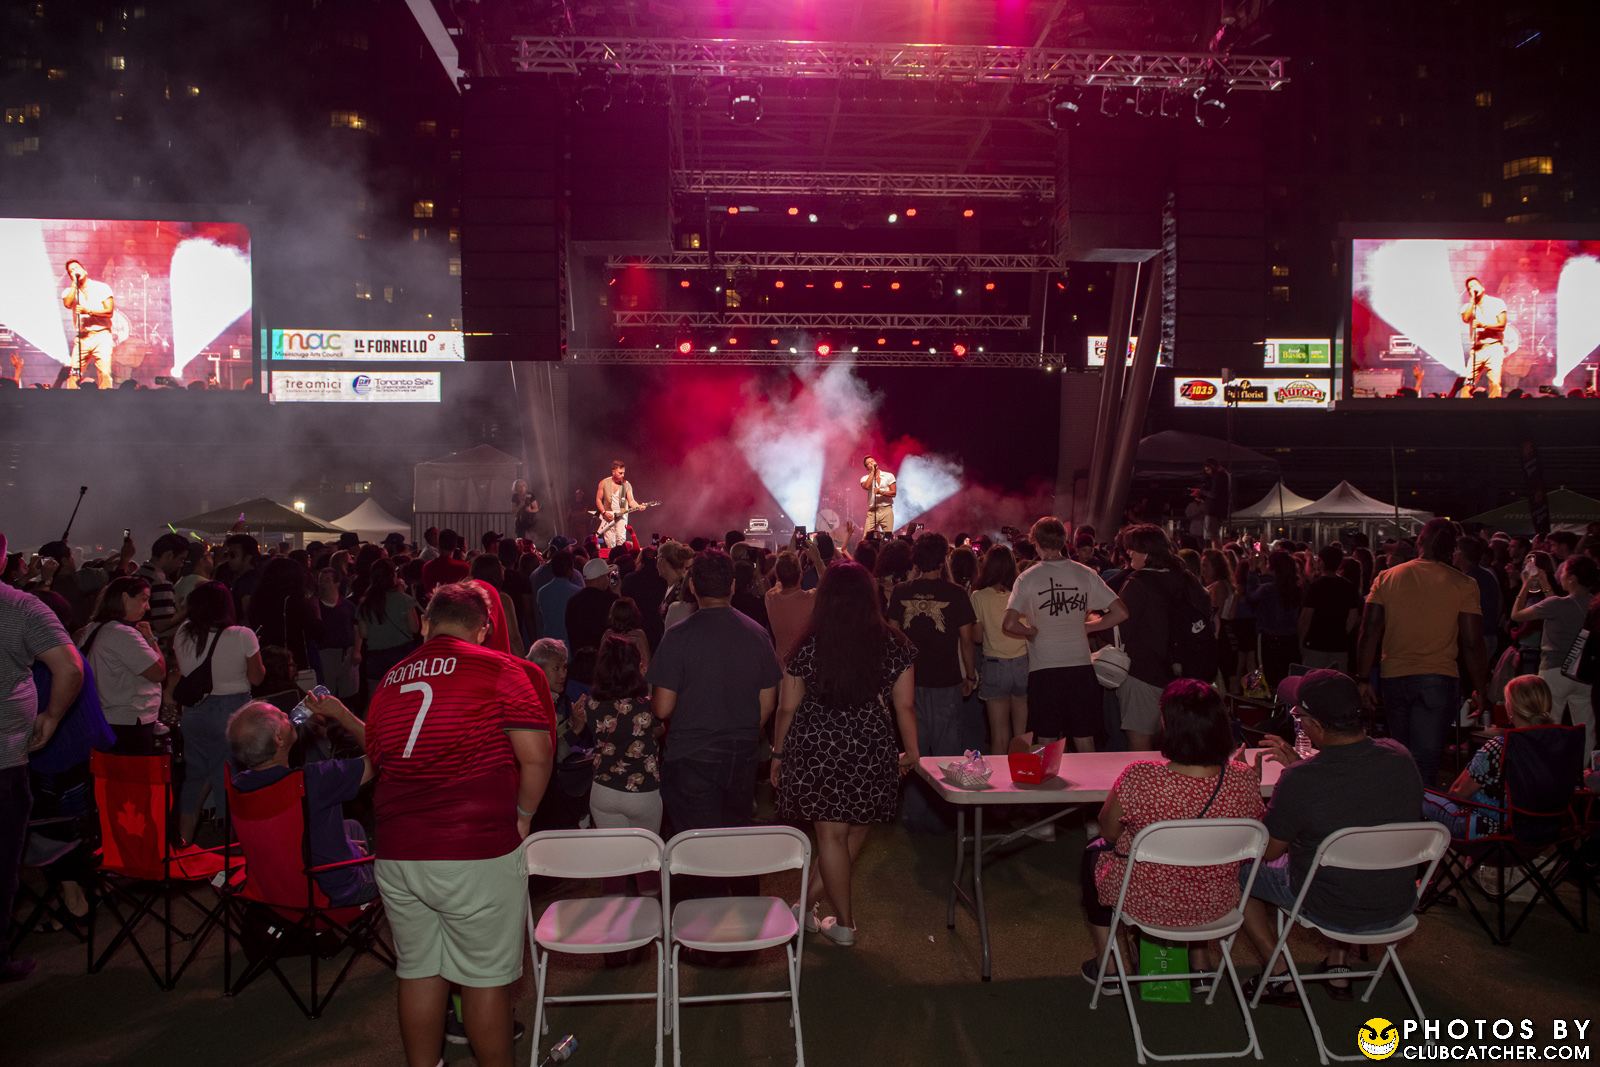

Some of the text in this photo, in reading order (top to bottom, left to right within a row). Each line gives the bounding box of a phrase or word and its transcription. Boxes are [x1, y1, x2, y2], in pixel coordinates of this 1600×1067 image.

[368, 339, 428, 352] FORNELLO
[286, 378, 342, 389] tre amici
[415, 378, 434, 386] Salt
[1277, 387, 1324, 400] Aurora
[384, 657, 457, 688] RONALDO
[400, 681, 433, 759] 7
